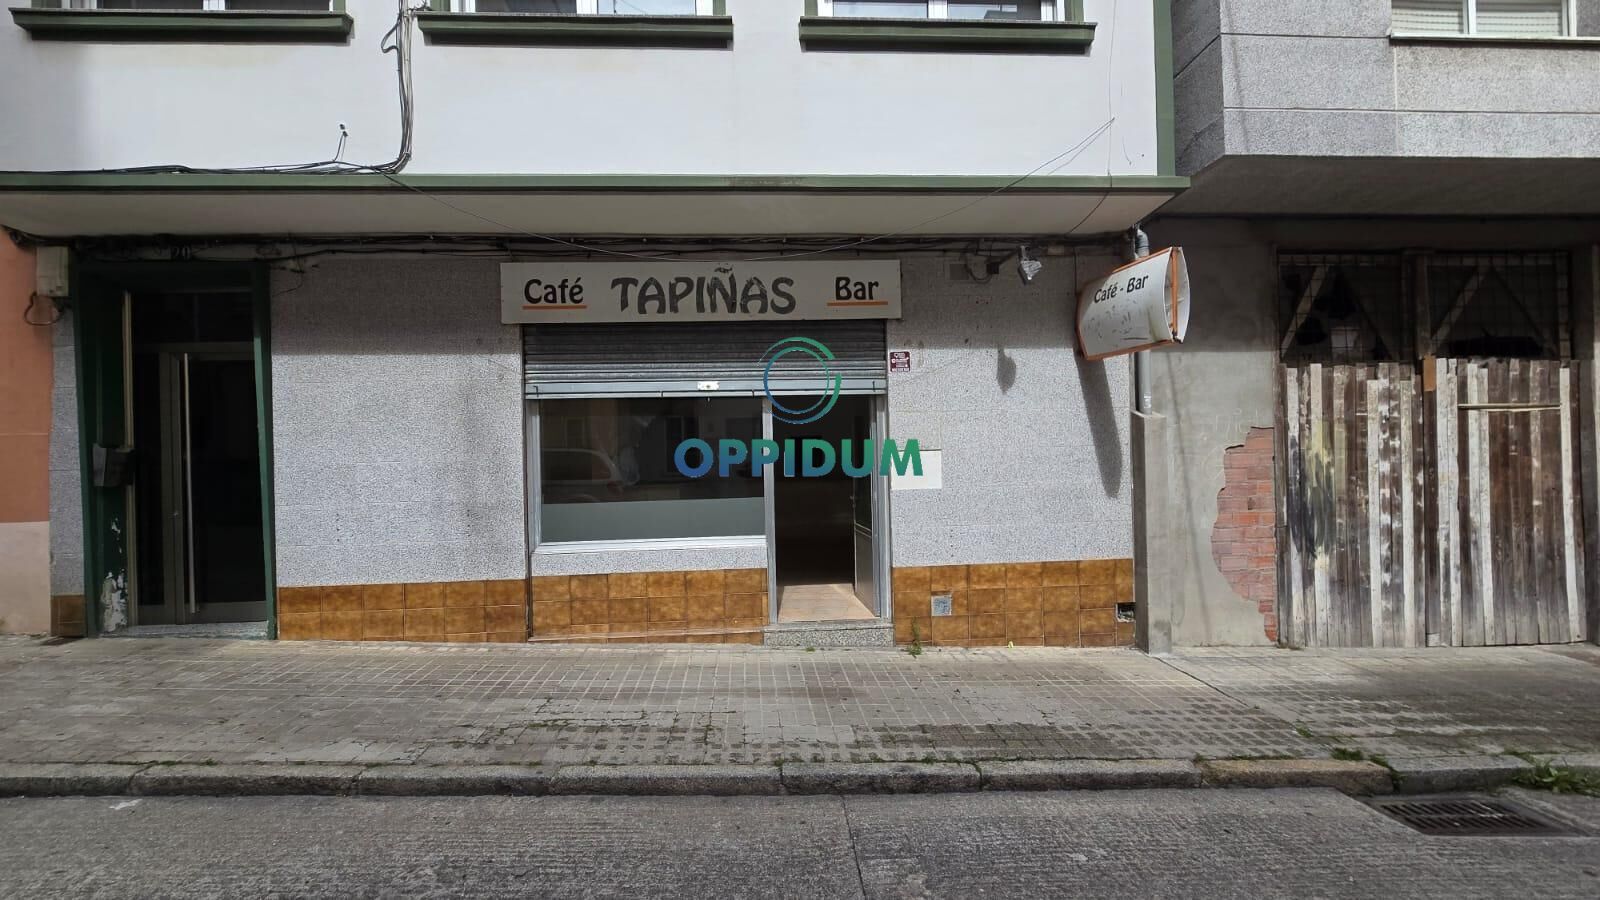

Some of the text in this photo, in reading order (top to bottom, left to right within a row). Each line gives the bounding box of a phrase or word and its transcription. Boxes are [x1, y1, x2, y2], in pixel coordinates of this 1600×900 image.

[524, 264, 879, 315] Café TAPIÑAS Bar
[1094, 282, 1118, 303] Café
[1126, 275, 1149, 293] Bar
